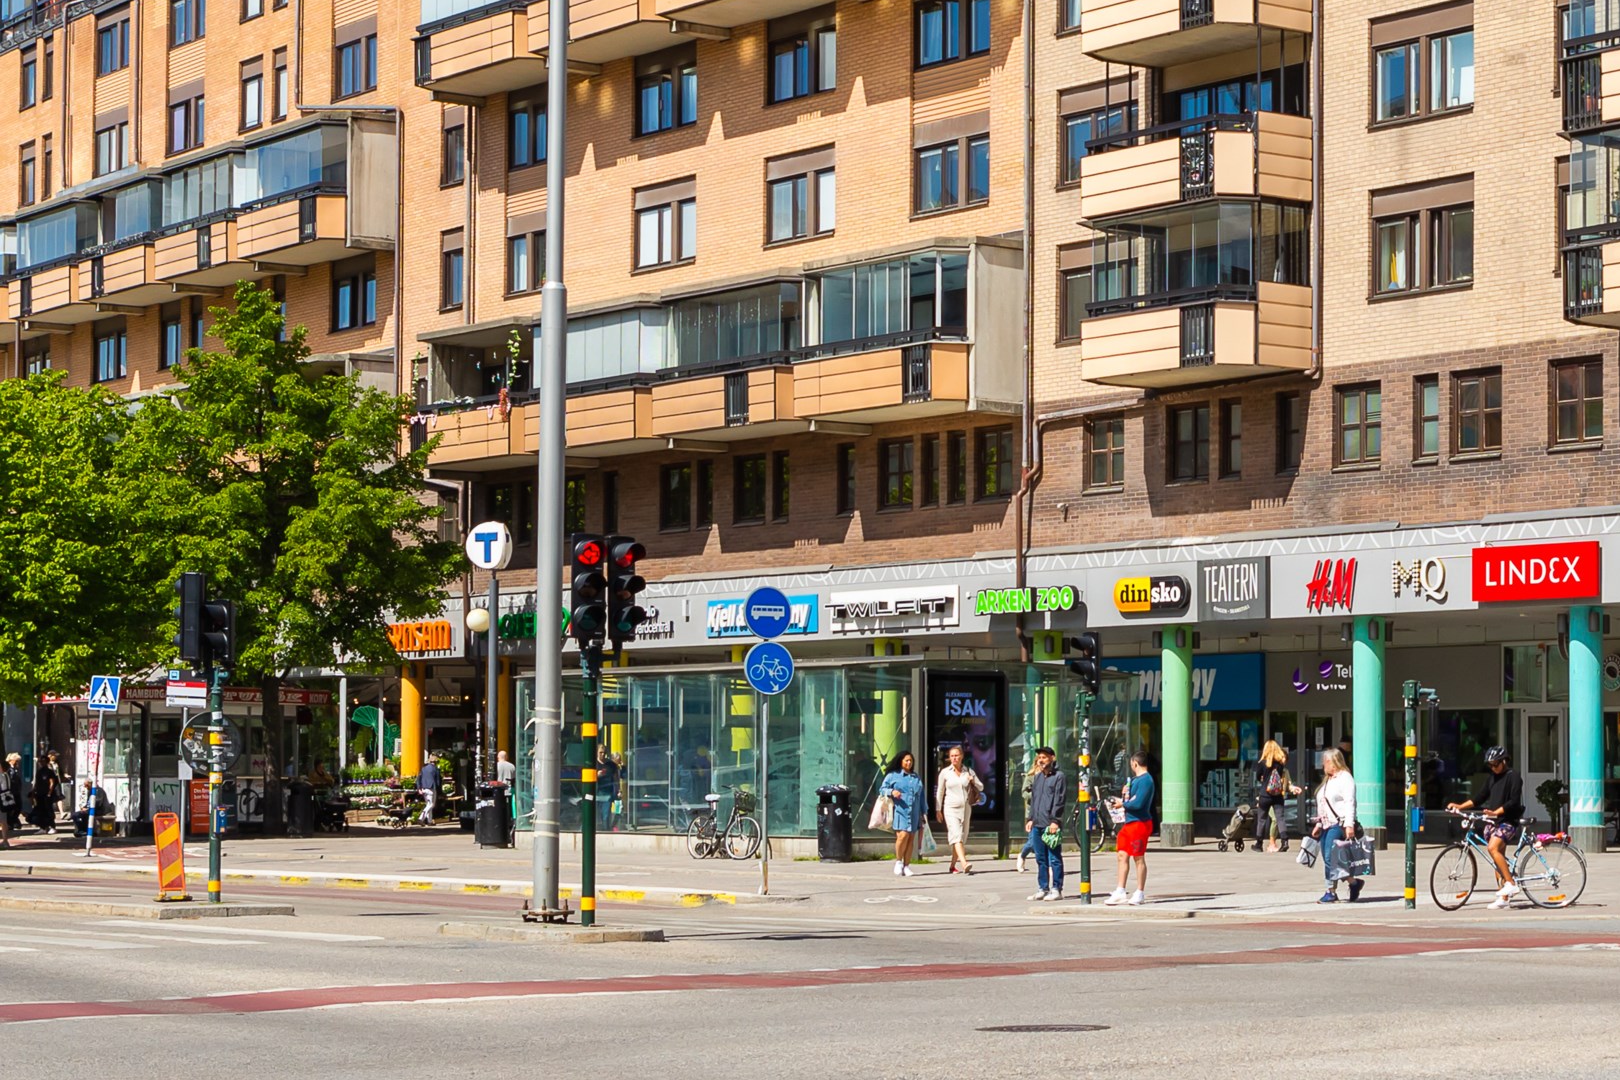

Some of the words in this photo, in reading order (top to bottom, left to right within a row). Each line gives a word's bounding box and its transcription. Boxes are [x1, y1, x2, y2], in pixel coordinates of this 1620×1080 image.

[475, 532, 498, 563] T
[1203, 563, 1259, 604] TEATERN
[1306, 557, 1357, 612] H&M
[1391, 557, 1449, 602] MQ
[1485, 556, 1581, 587] LINDEX
[825, 598, 946, 619] TWILFIT
[976, 588, 1031, 615] ARKEN
[1036, 586, 1074, 611] ZOO
[708, 604, 736, 632] Kjell
[1335, 664, 1353, 678] Tel
[126, 689, 166, 699] HAMBURG
[945, 699, 987, 717] ISAK
